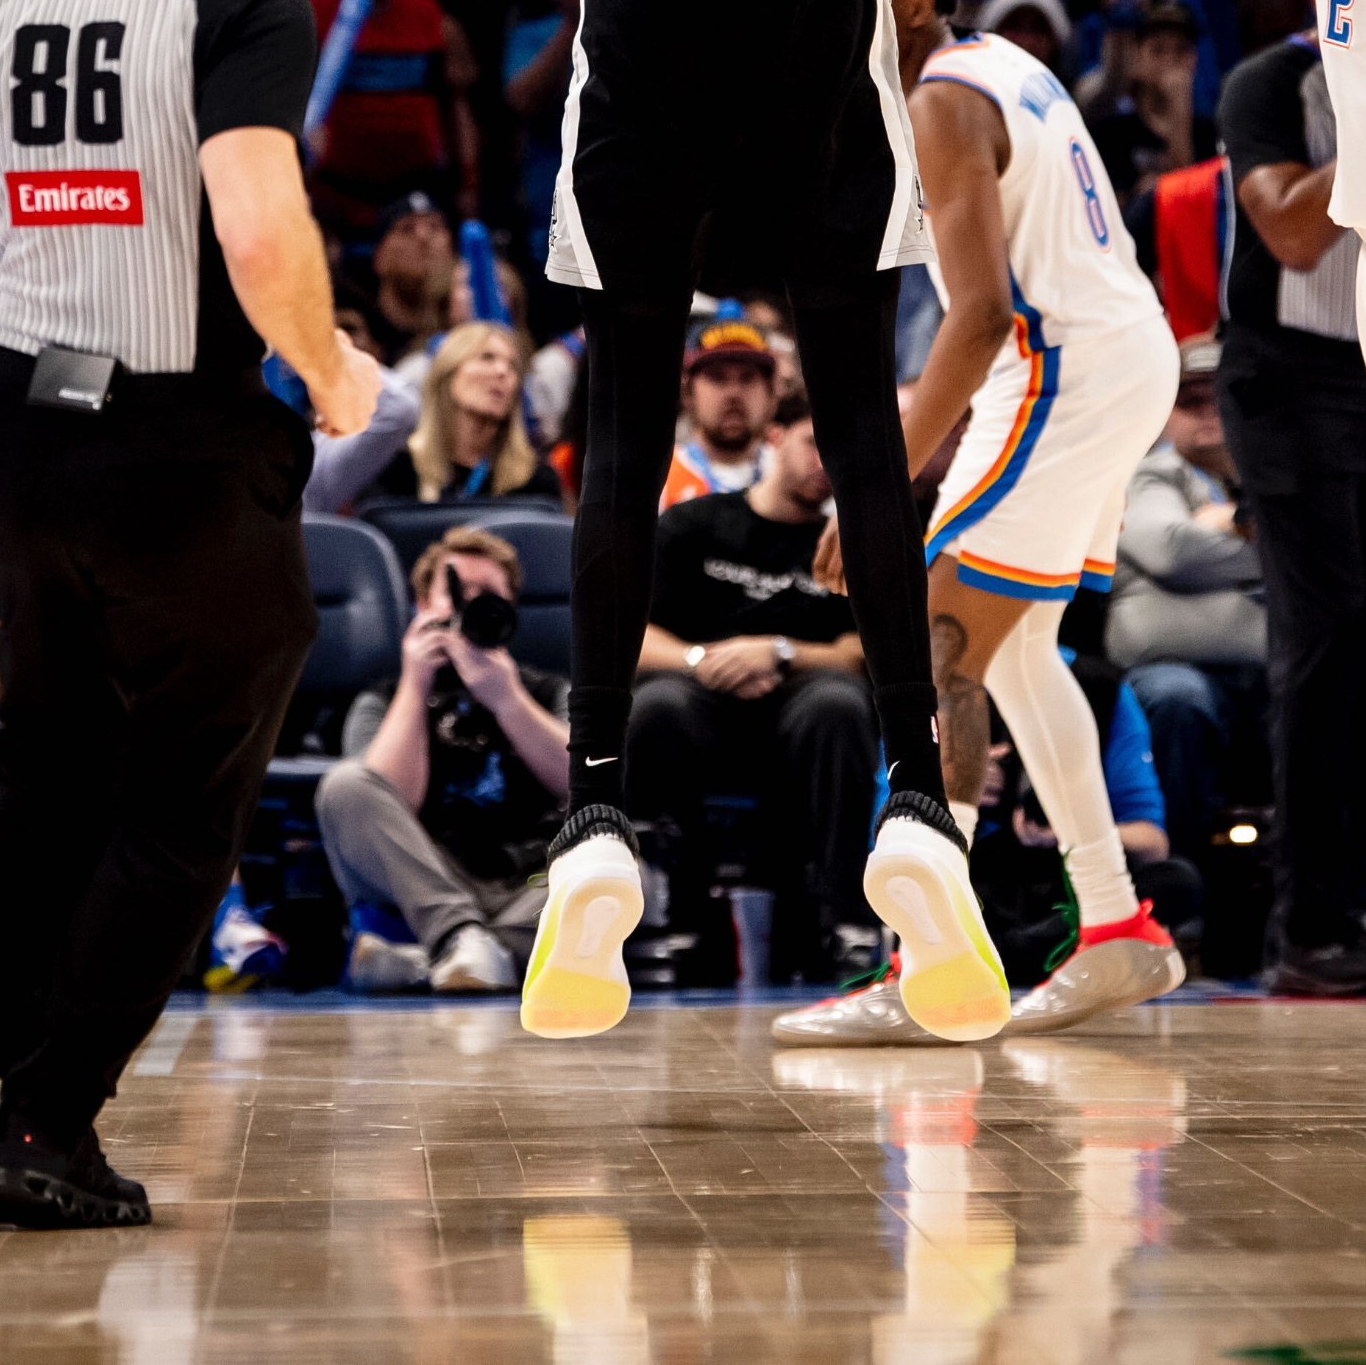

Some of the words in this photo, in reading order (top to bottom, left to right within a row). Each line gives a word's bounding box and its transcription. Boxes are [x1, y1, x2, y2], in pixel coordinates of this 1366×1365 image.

[11, 21, 126, 146] 86
[18, 183, 131, 213] Emirates
[1069, 136, 1111, 254] 8
